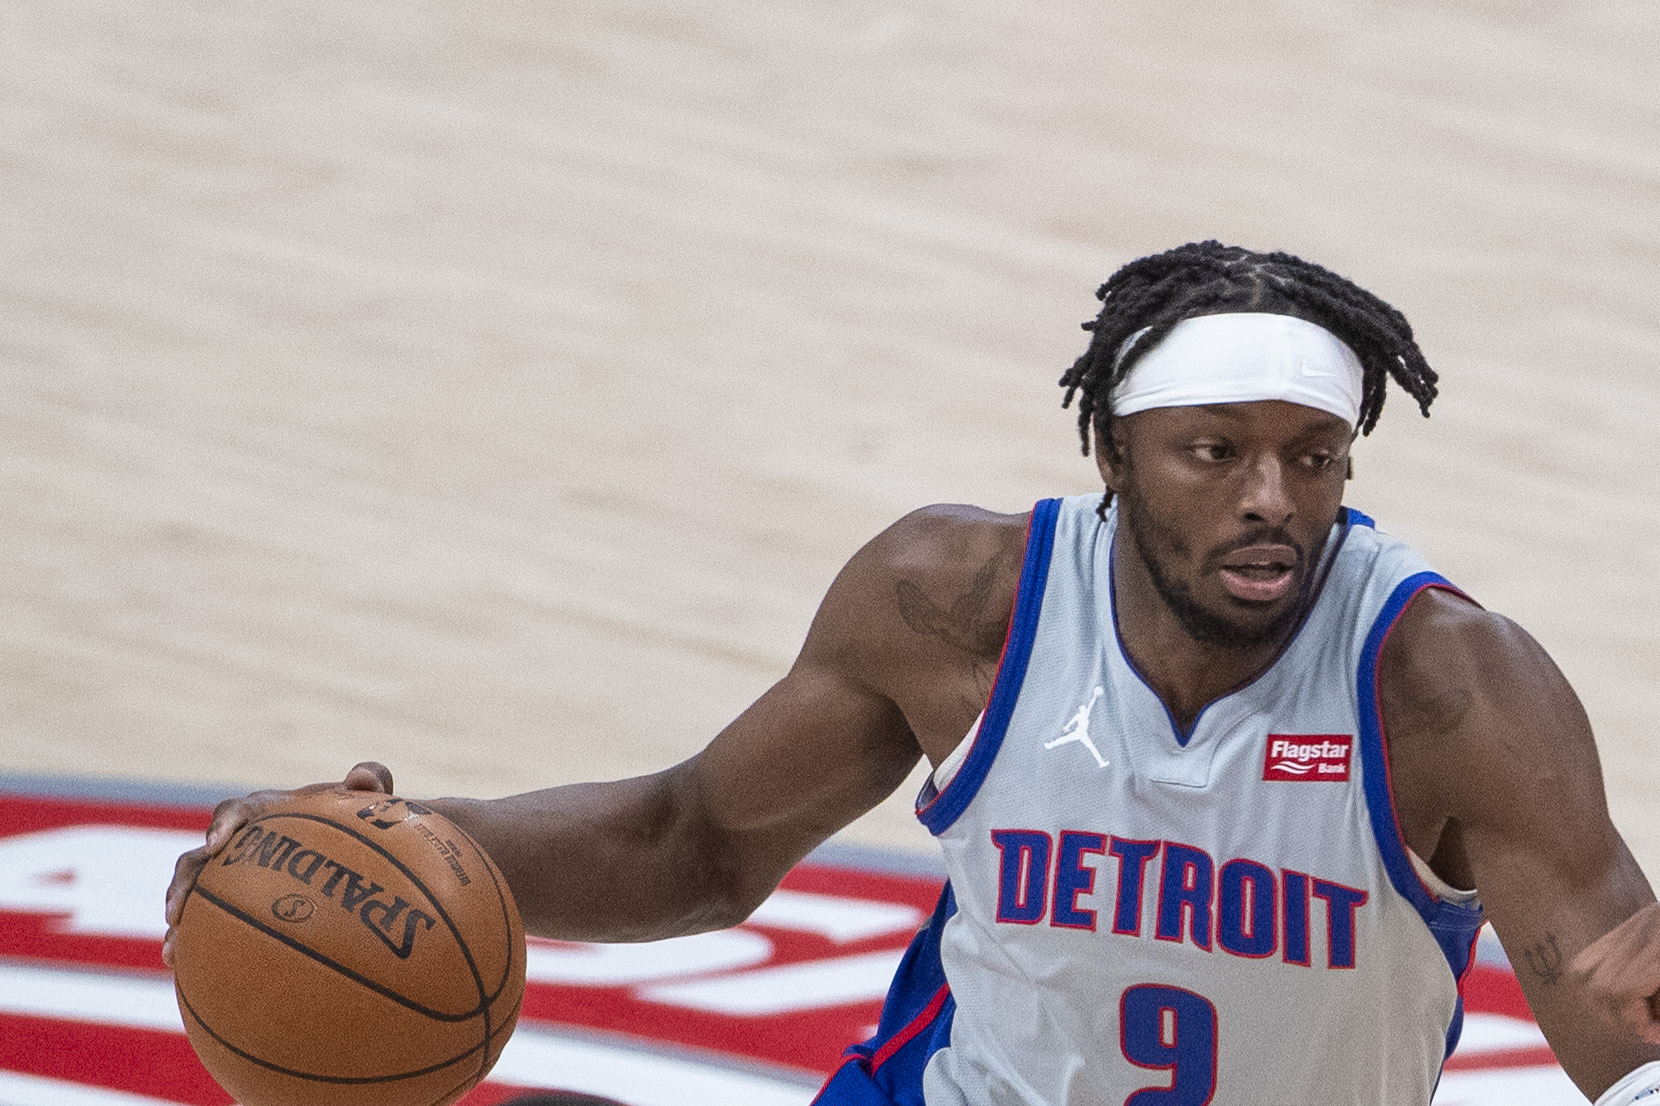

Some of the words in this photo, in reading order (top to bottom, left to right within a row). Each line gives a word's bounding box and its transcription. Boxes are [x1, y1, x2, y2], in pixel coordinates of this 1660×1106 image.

[1271, 740, 1349, 762] Flagstar
[1317, 763, 1346, 774] Bank
[221, 825, 436, 959] SPALDING
[990, 828, 1369, 970] DETROIT
